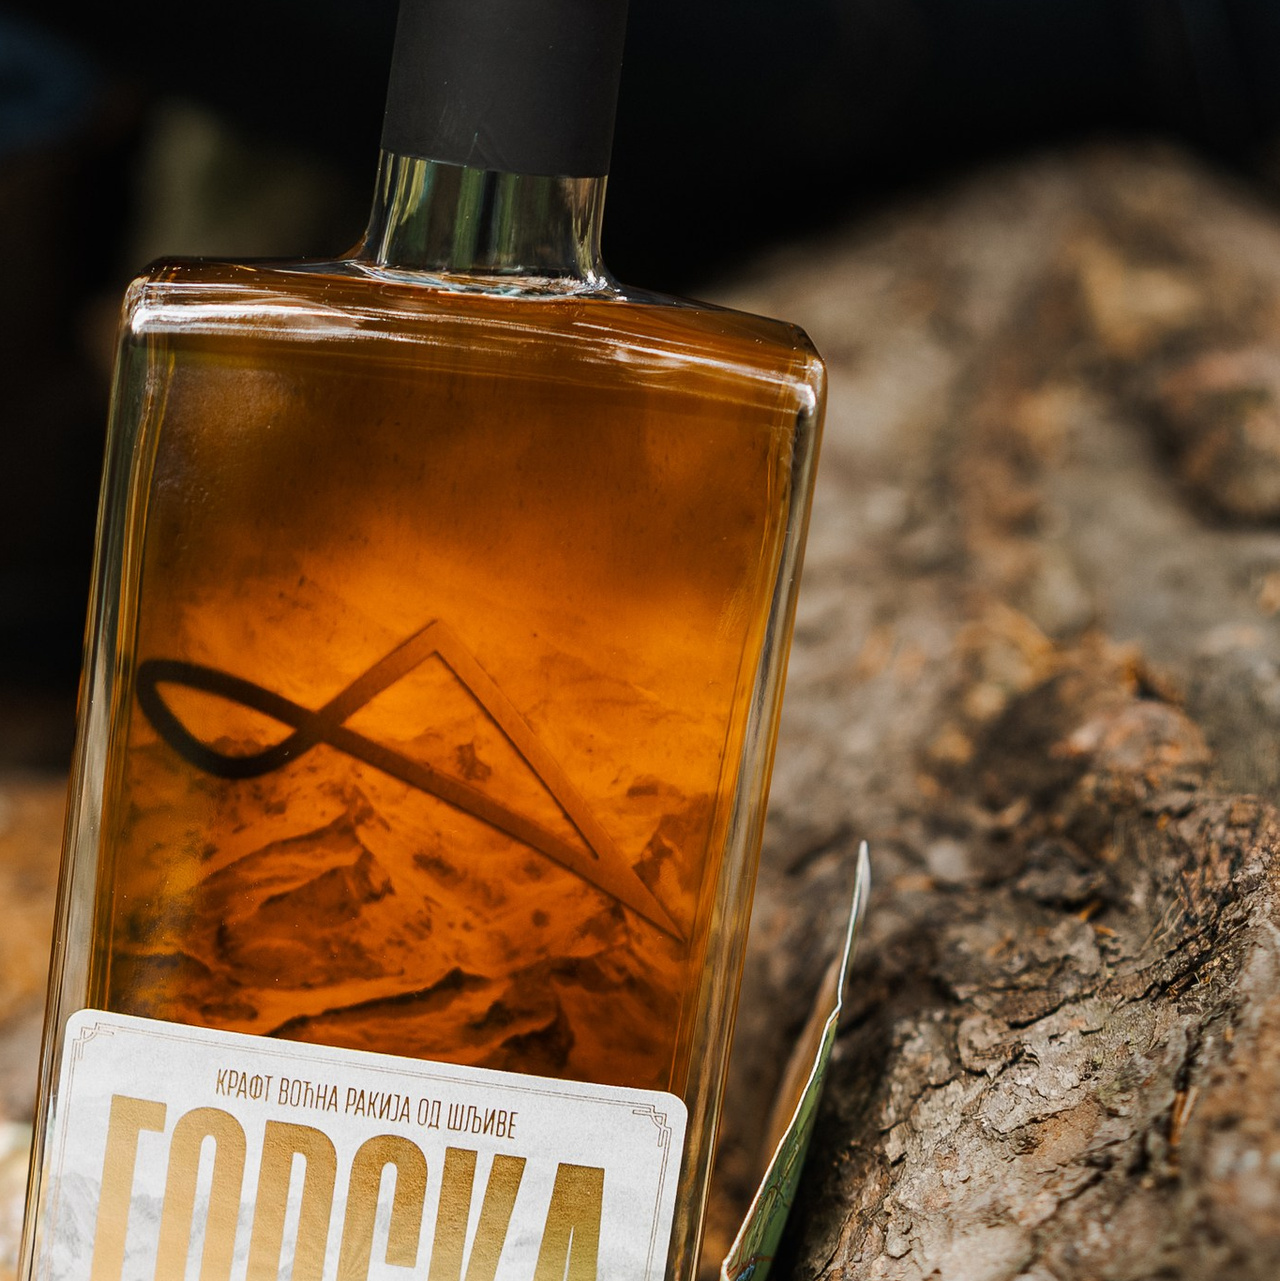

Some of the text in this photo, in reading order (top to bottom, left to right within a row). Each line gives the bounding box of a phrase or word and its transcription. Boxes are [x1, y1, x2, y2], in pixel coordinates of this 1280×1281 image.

[216, 1068, 519, 1140] КРАФТ ВОЋНА РАКИЈА ОД ШЉИВЕ
